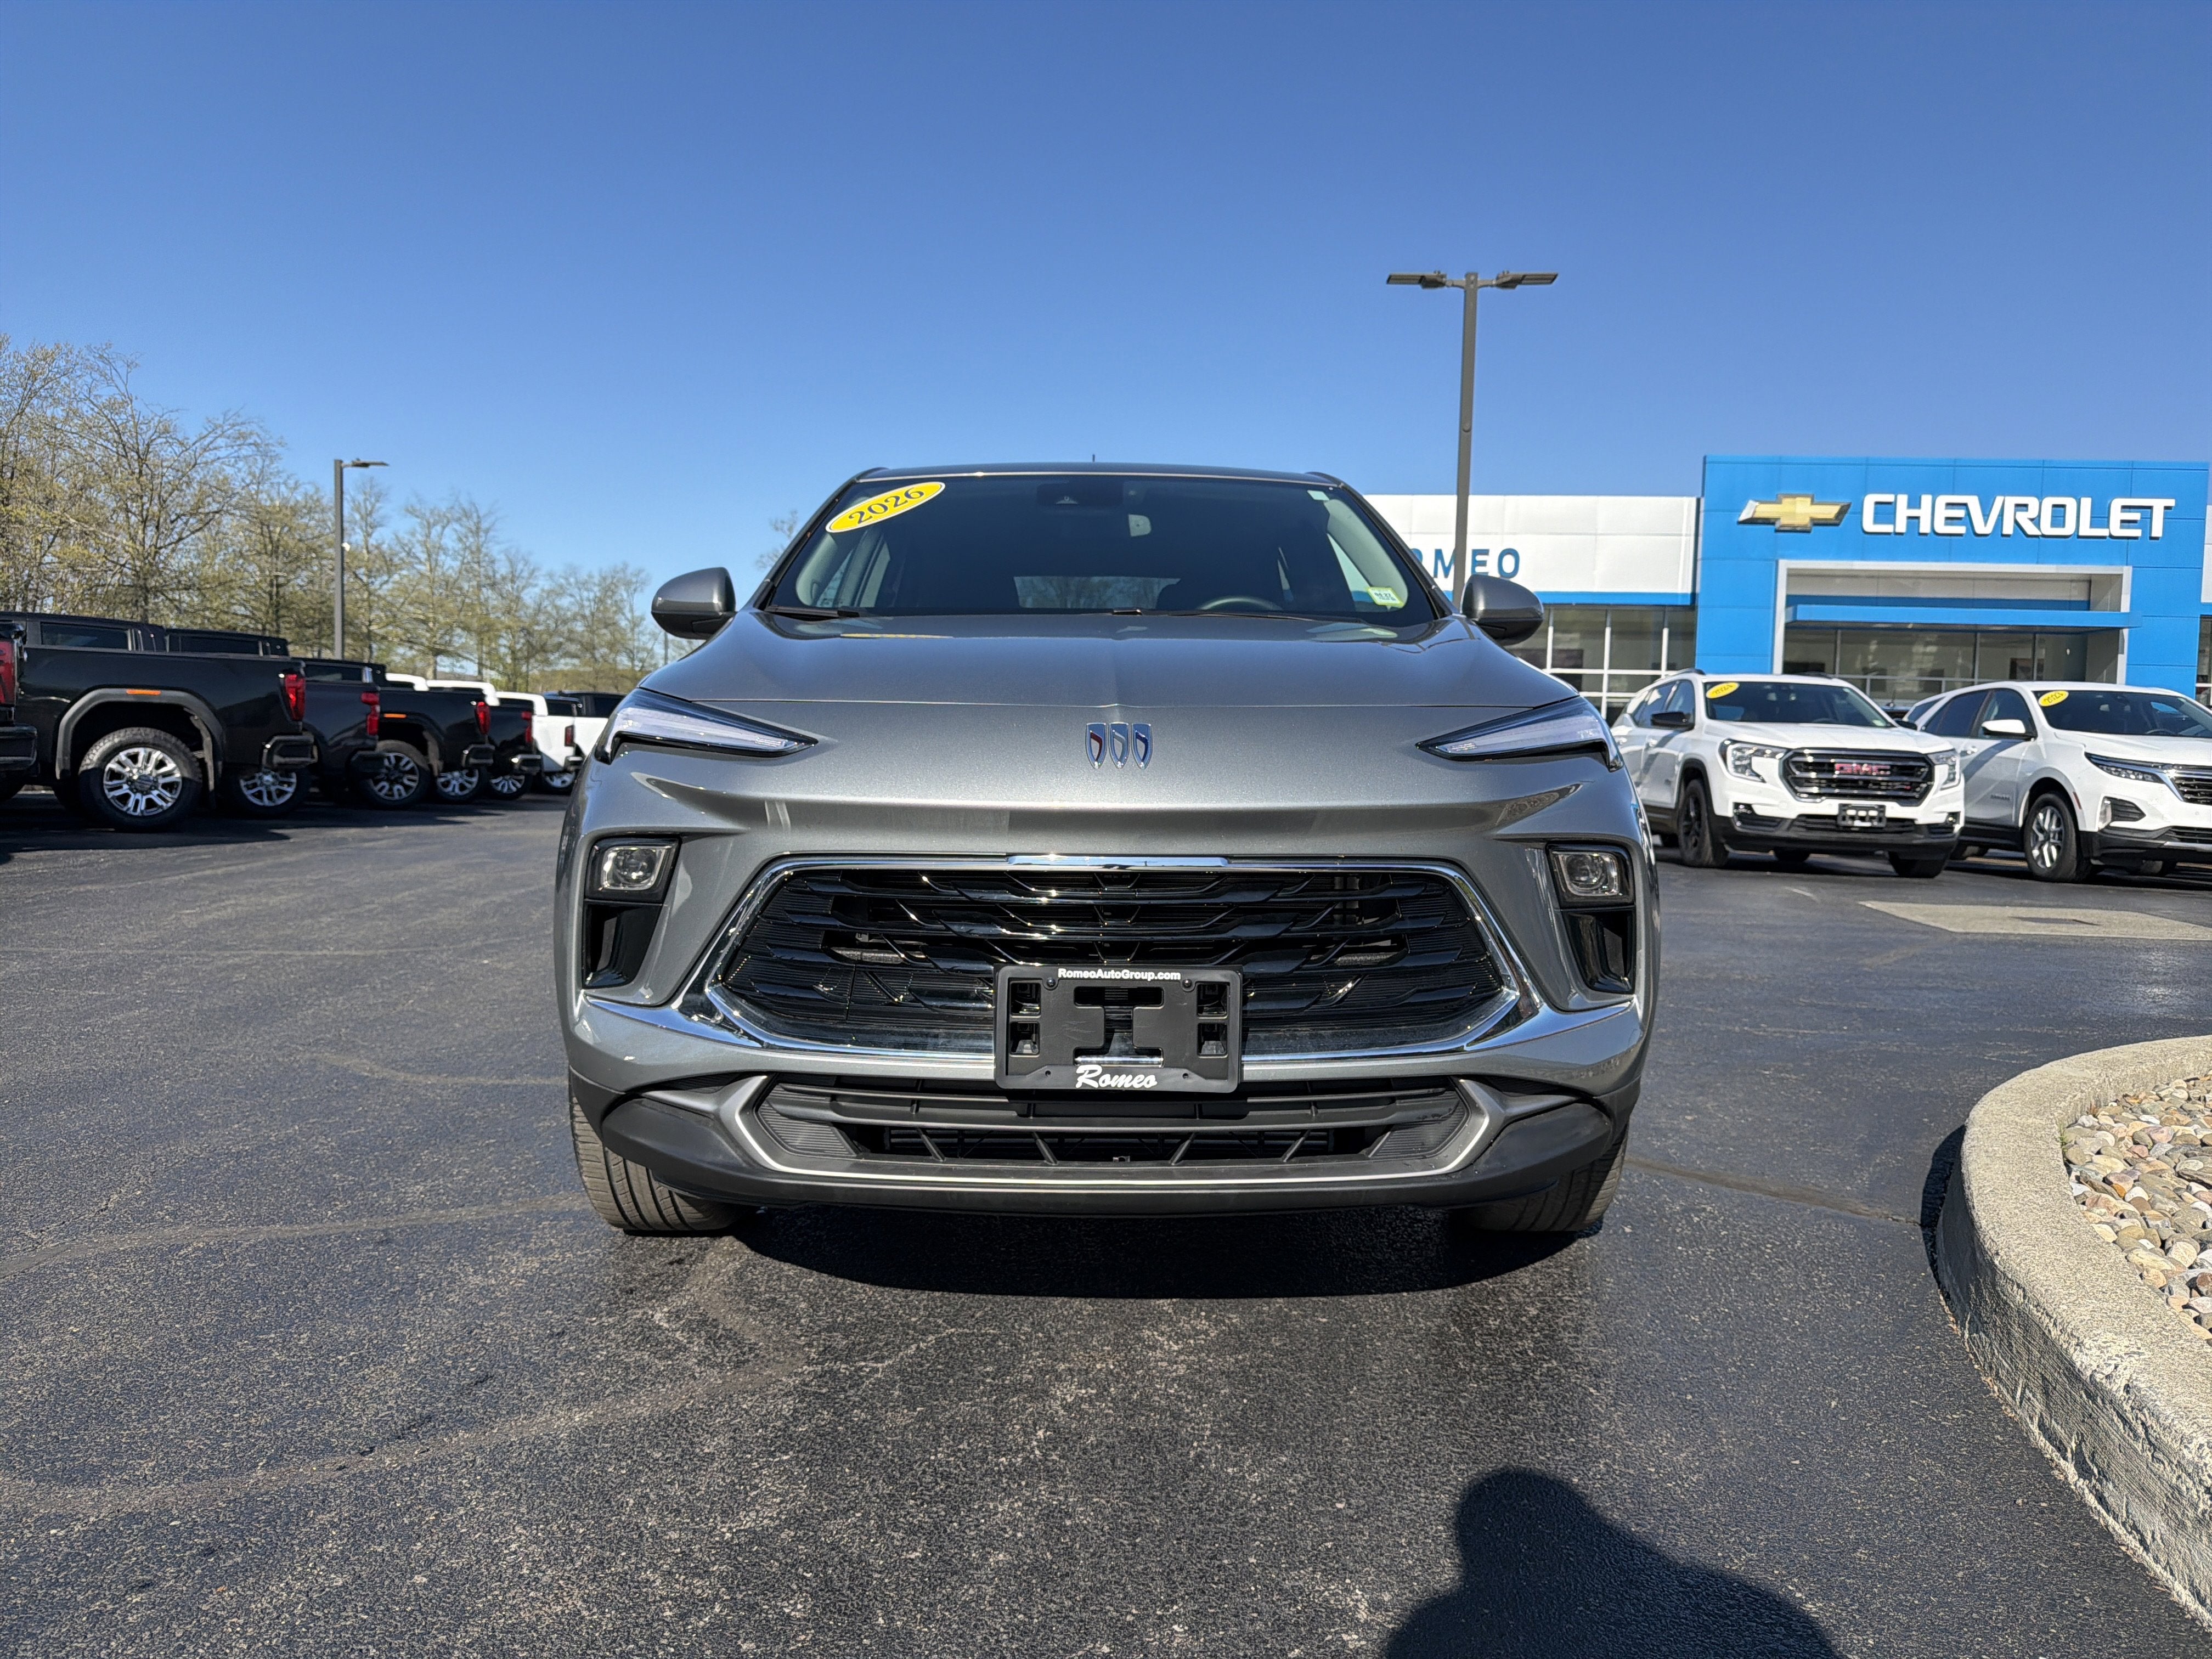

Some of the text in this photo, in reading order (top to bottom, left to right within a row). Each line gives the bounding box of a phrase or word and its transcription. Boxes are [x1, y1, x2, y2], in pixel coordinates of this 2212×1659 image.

[848, 487, 924, 524] 2026
[1862, 494, 2175, 539] CHEVROLET
[1412, 548, 1520, 579] MEO
[1834, 763, 1891, 775] GMC
[1058, 968, 1181, 981] RomeoAutoGroup.com
[1075, 1064, 1158, 1088] Romeo
